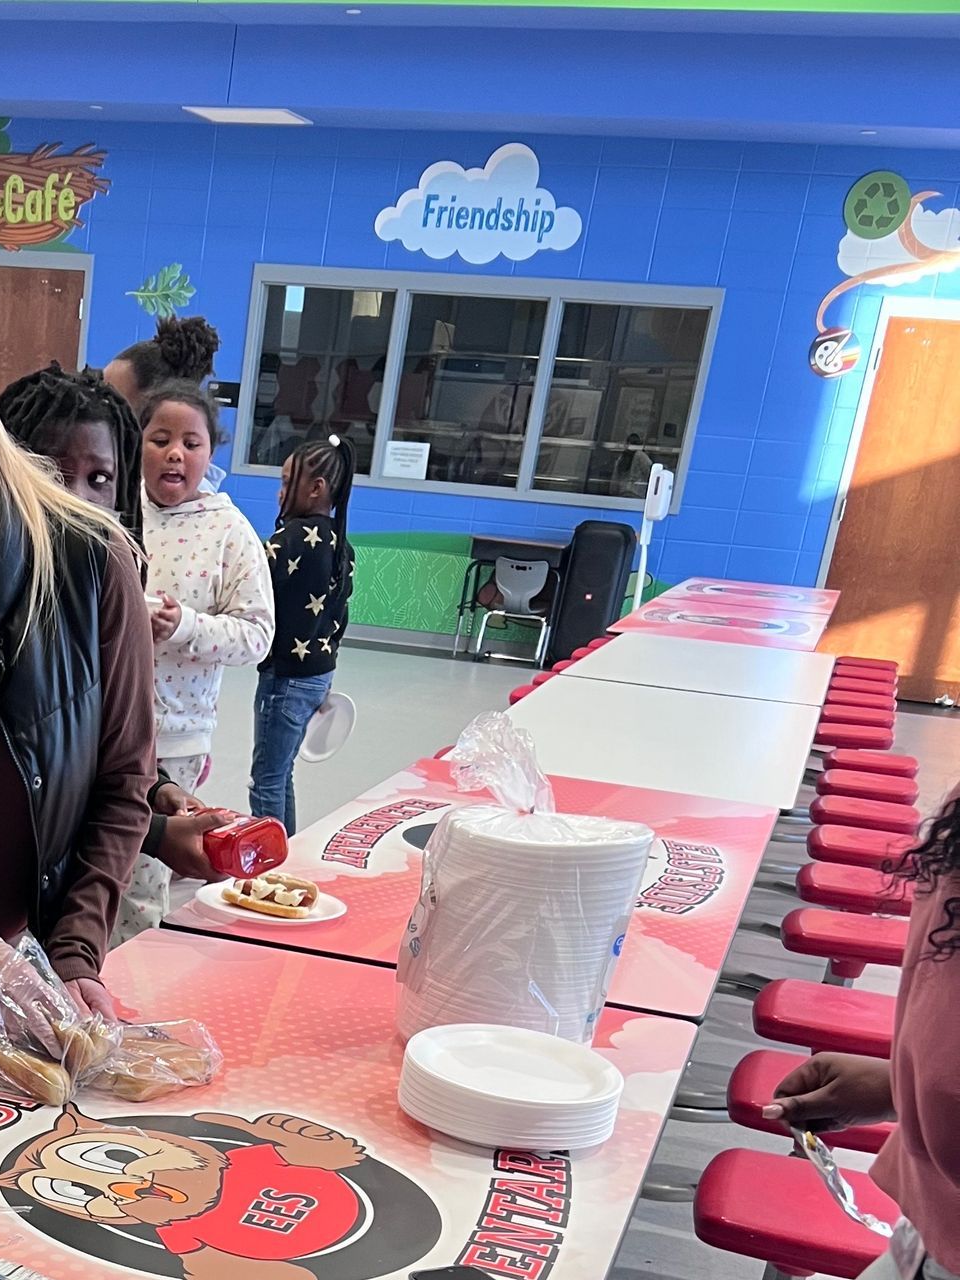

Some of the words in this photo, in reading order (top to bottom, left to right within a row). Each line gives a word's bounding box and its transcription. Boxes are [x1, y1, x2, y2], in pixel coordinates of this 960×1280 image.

[4, 171, 76, 224] Café
[421, 193, 556, 244] Friendship
[239, 1187, 319, 1235] EES
